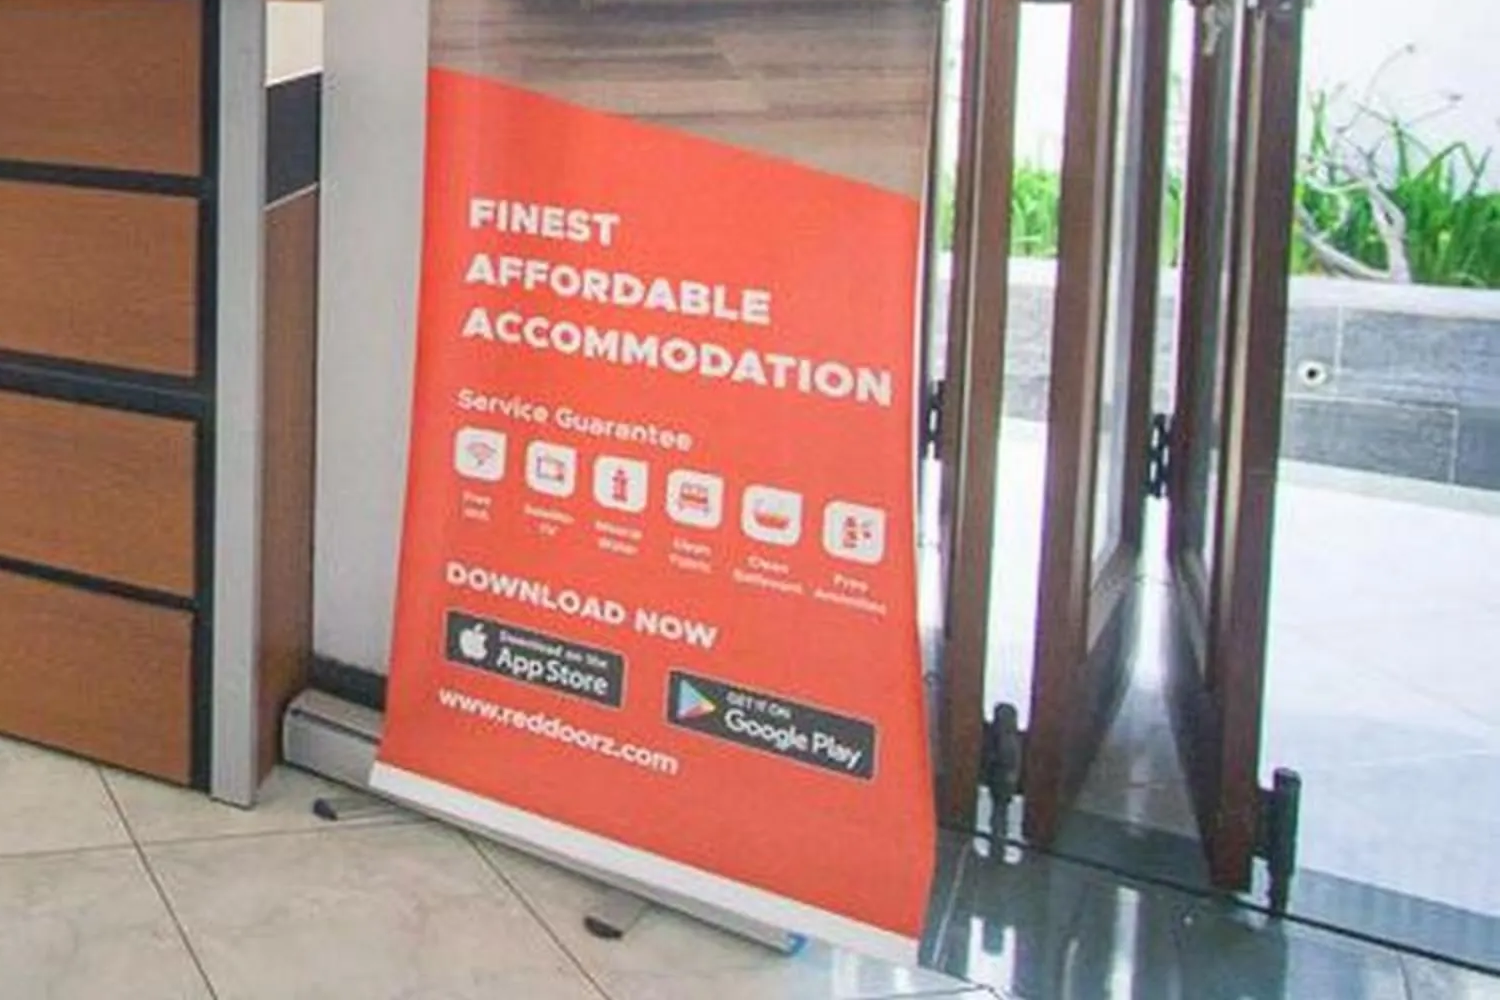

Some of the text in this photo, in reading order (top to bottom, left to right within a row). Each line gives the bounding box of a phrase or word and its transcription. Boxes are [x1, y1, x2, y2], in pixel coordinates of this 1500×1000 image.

[467, 198, 621, 246] FINEST
[464, 252, 773, 327] AFFORDABLE
[461, 307, 894, 407] ACCOMMODATION
[456, 388, 694, 452] Service Guarantee
[445, 561, 721, 650] DOWNLOAD NOW
[496, 647, 609, 696] App Store
[439, 688, 680, 776] www.reddoorz.com
[724, 708, 863, 770] Google Play
